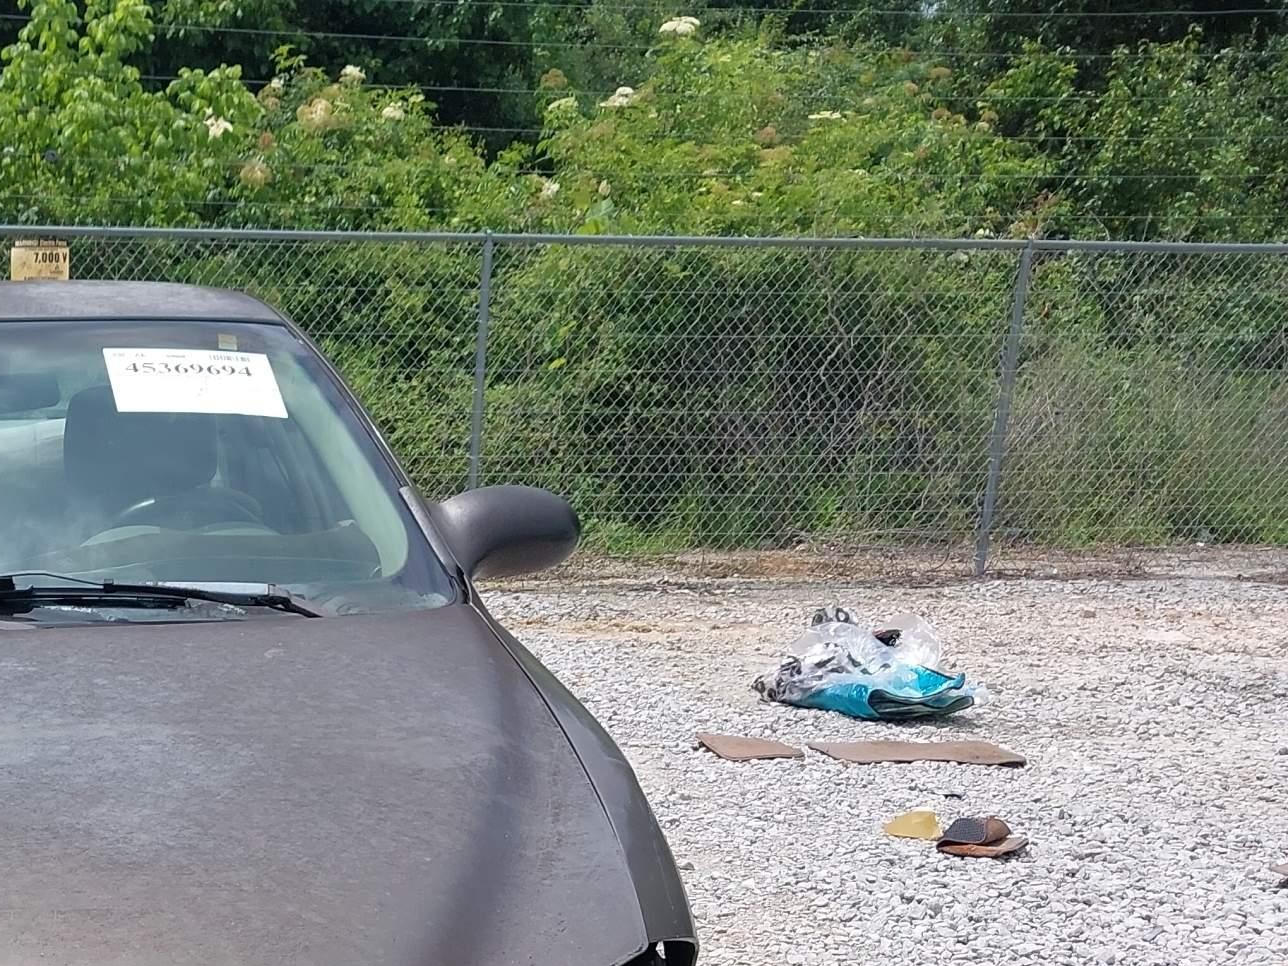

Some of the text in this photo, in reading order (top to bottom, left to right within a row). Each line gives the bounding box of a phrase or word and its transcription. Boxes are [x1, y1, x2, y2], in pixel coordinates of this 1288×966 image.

[34, 252, 68, 264] 7,000 V
[125, 362, 252, 376] 45369694
